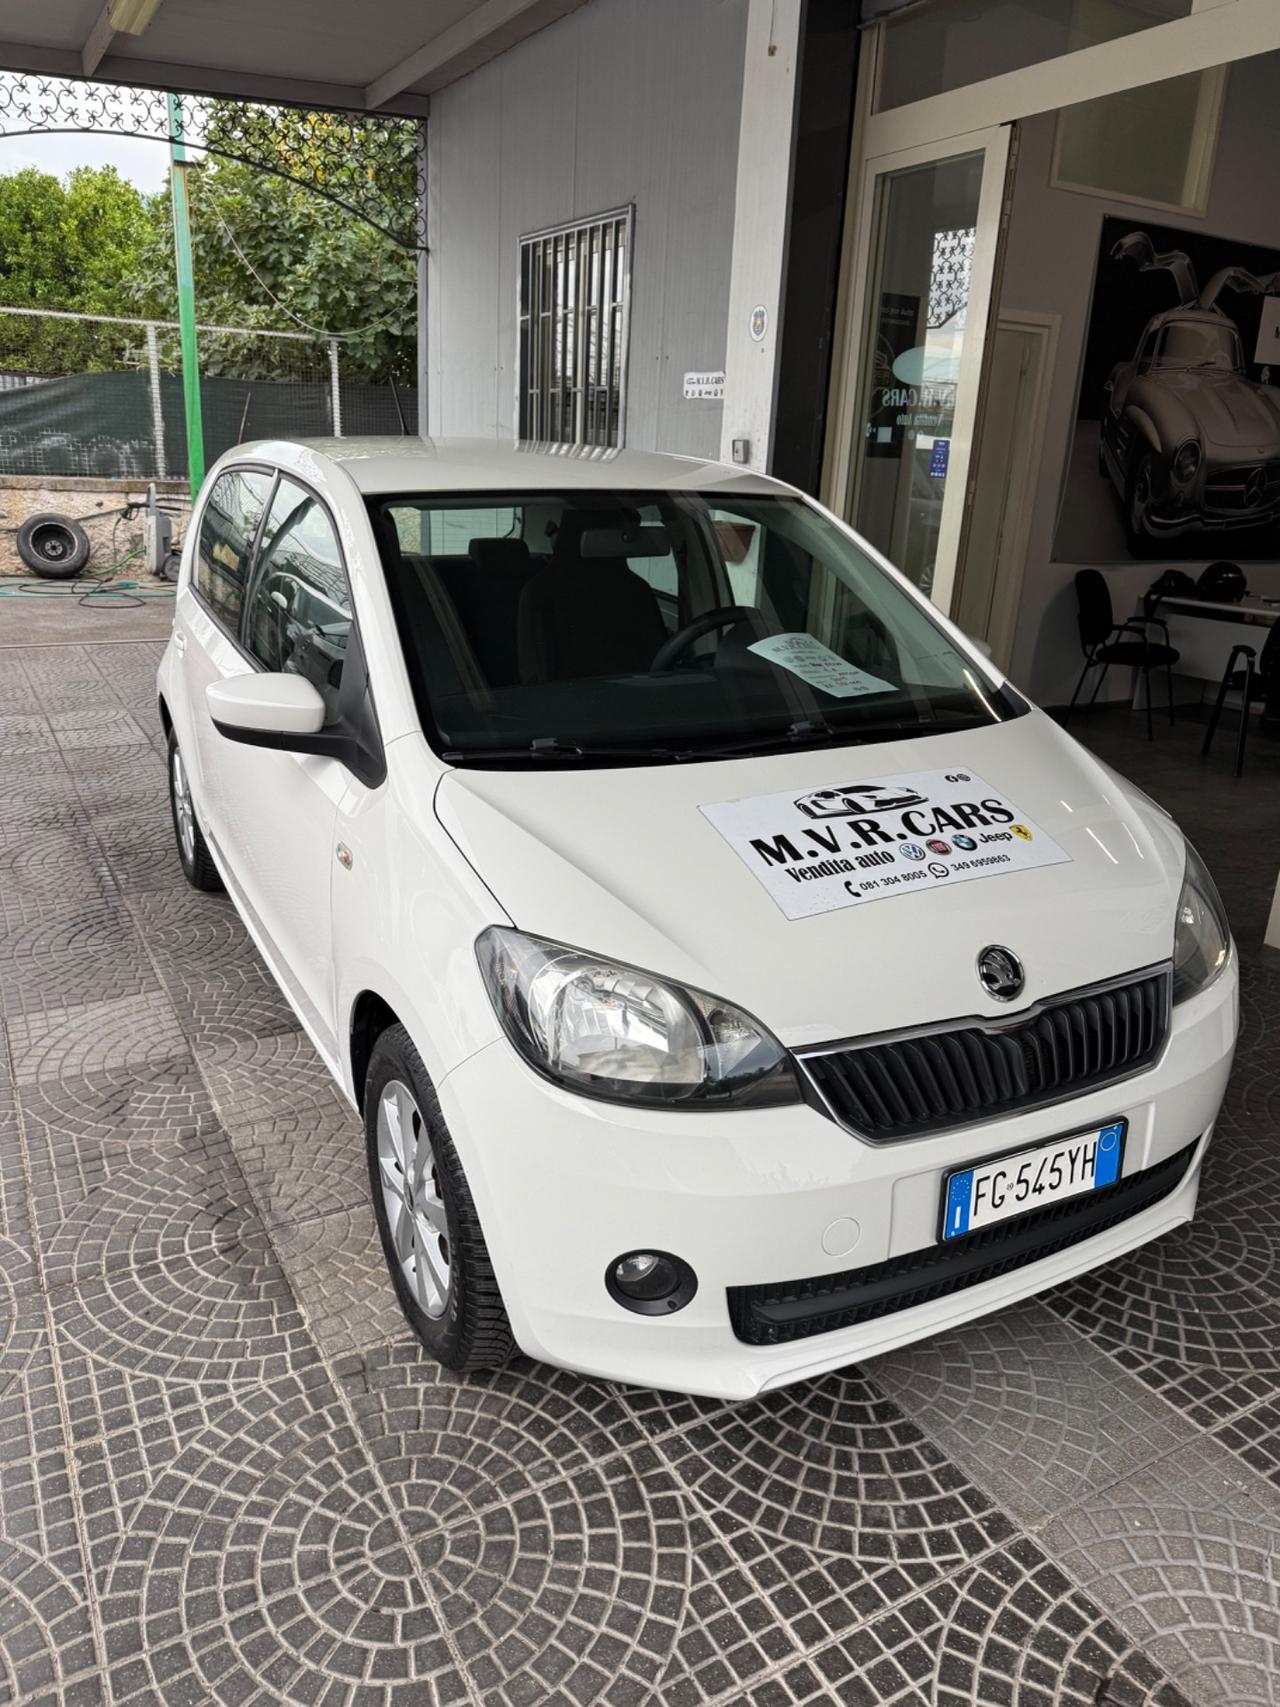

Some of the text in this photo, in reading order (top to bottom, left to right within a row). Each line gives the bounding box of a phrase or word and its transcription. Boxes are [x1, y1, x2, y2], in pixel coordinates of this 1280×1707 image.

[749, 799, 1014, 866] M.V.R.CARS
[979, 830, 1013, 844] Jeep
[784, 848, 896, 883] Vendita auto
[950, 861, 971, 871] 349
[859, 869, 928, 891] 081 304 8005
